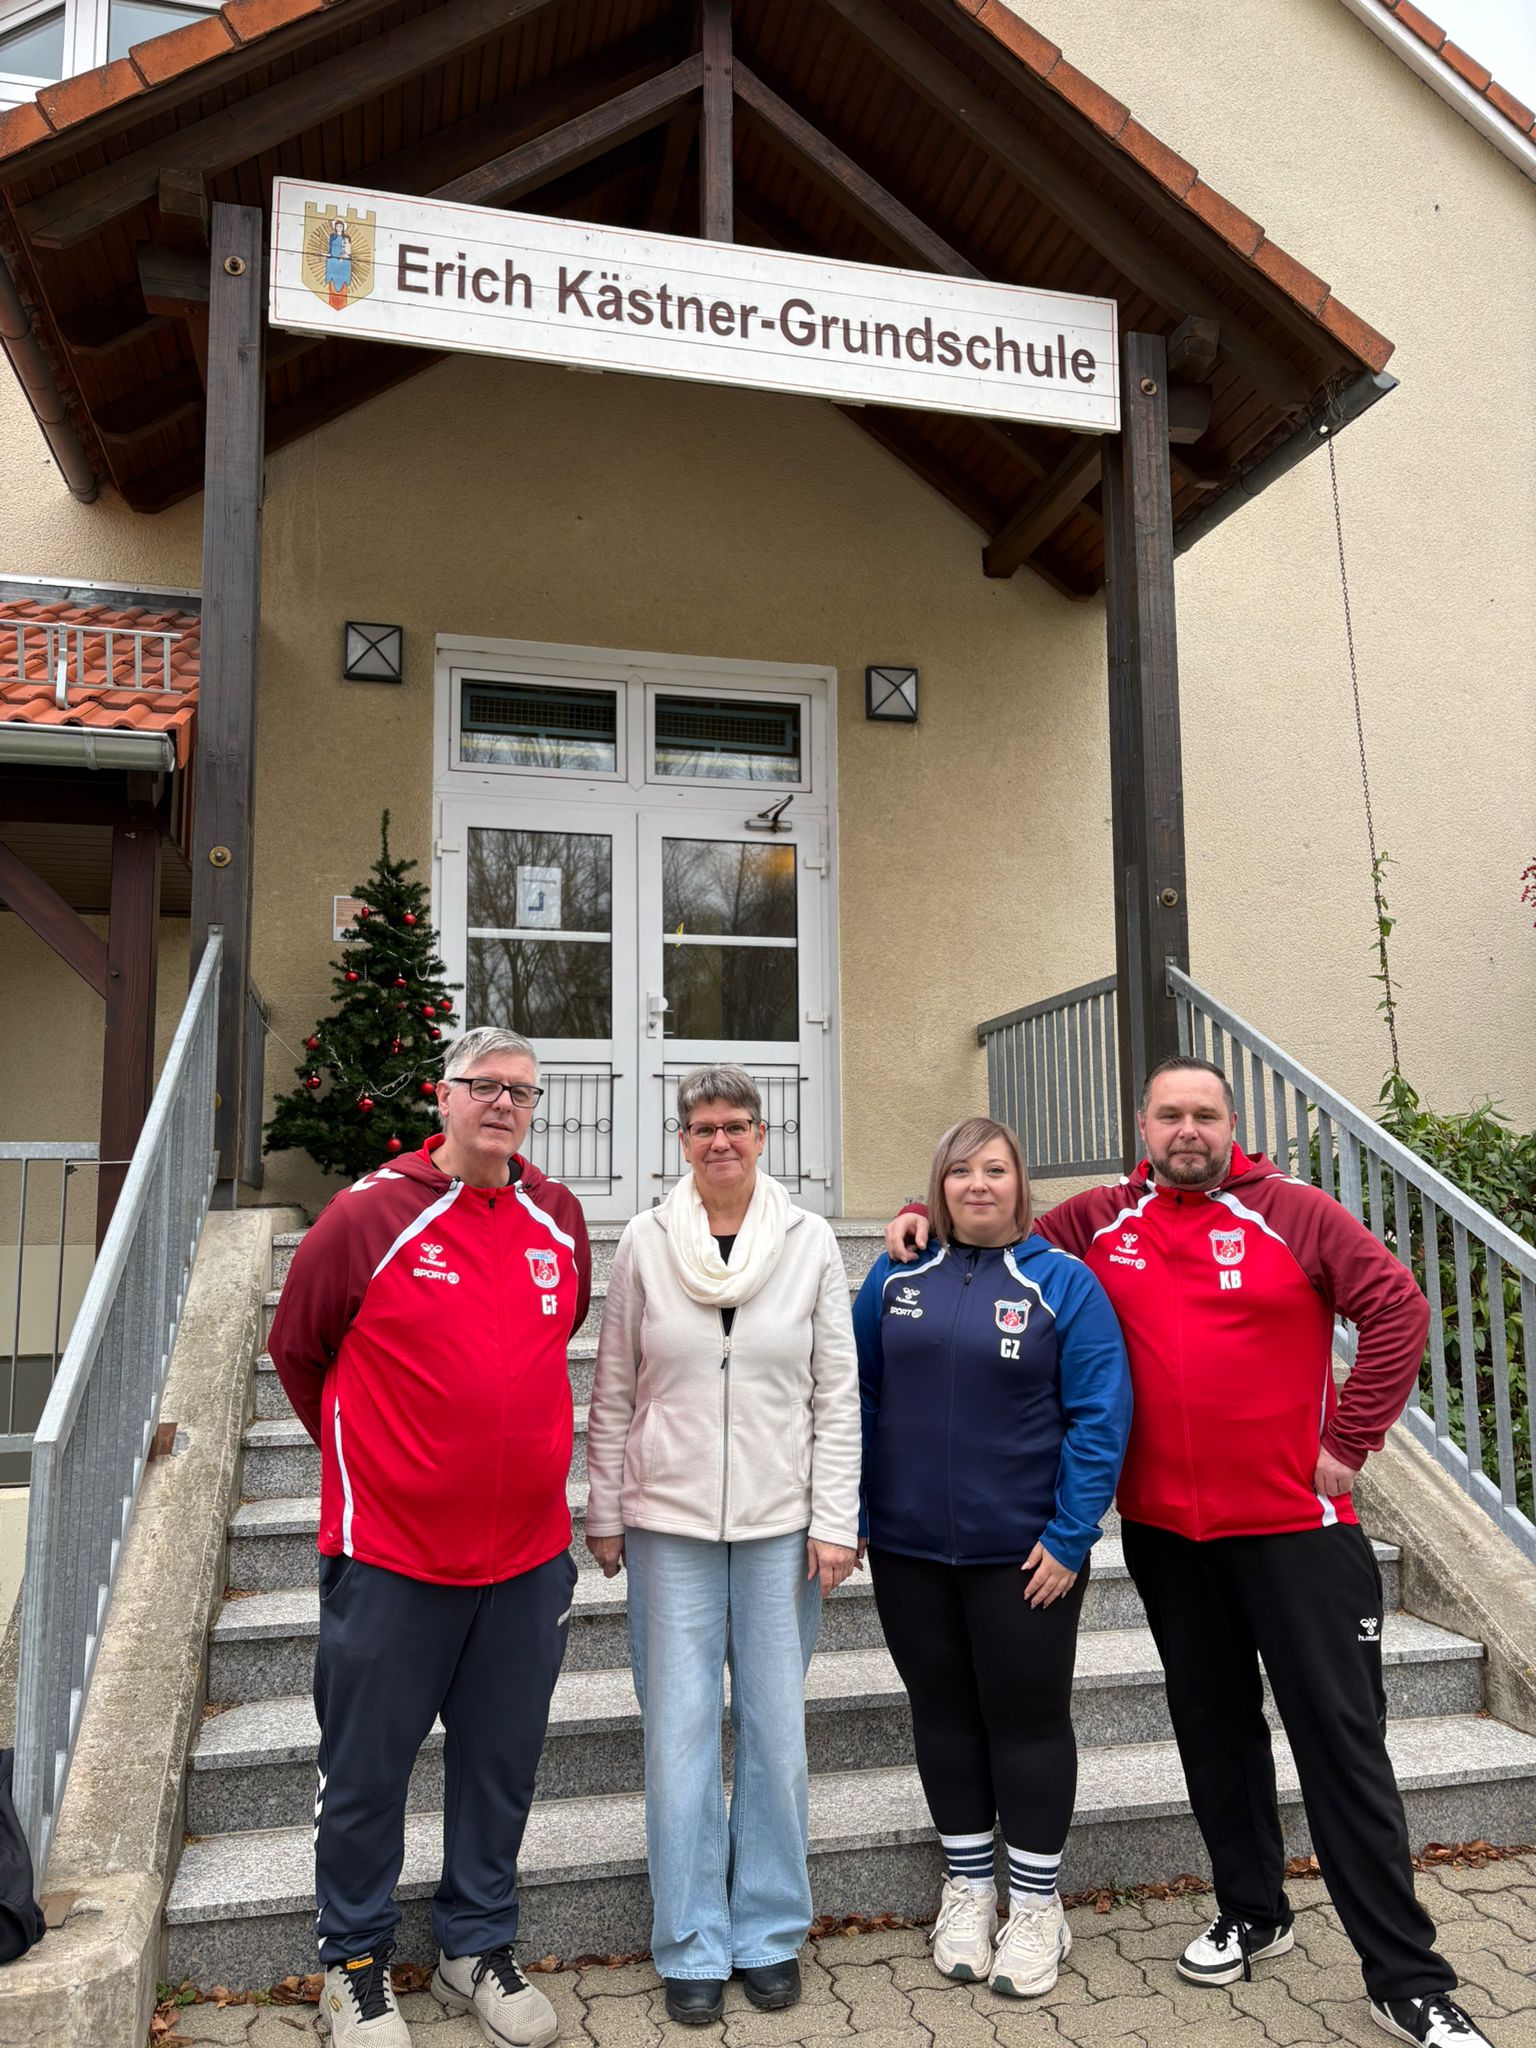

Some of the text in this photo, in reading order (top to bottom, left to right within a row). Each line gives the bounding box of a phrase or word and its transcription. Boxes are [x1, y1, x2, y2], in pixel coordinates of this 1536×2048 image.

[397, 244, 1097, 383] Erich Kästner-Grundschule
[413, 1268, 447, 1280] SPORT
[1219, 1269, 1242, 1290] KB
[1000, 1338, 1020, 1360] CZ
